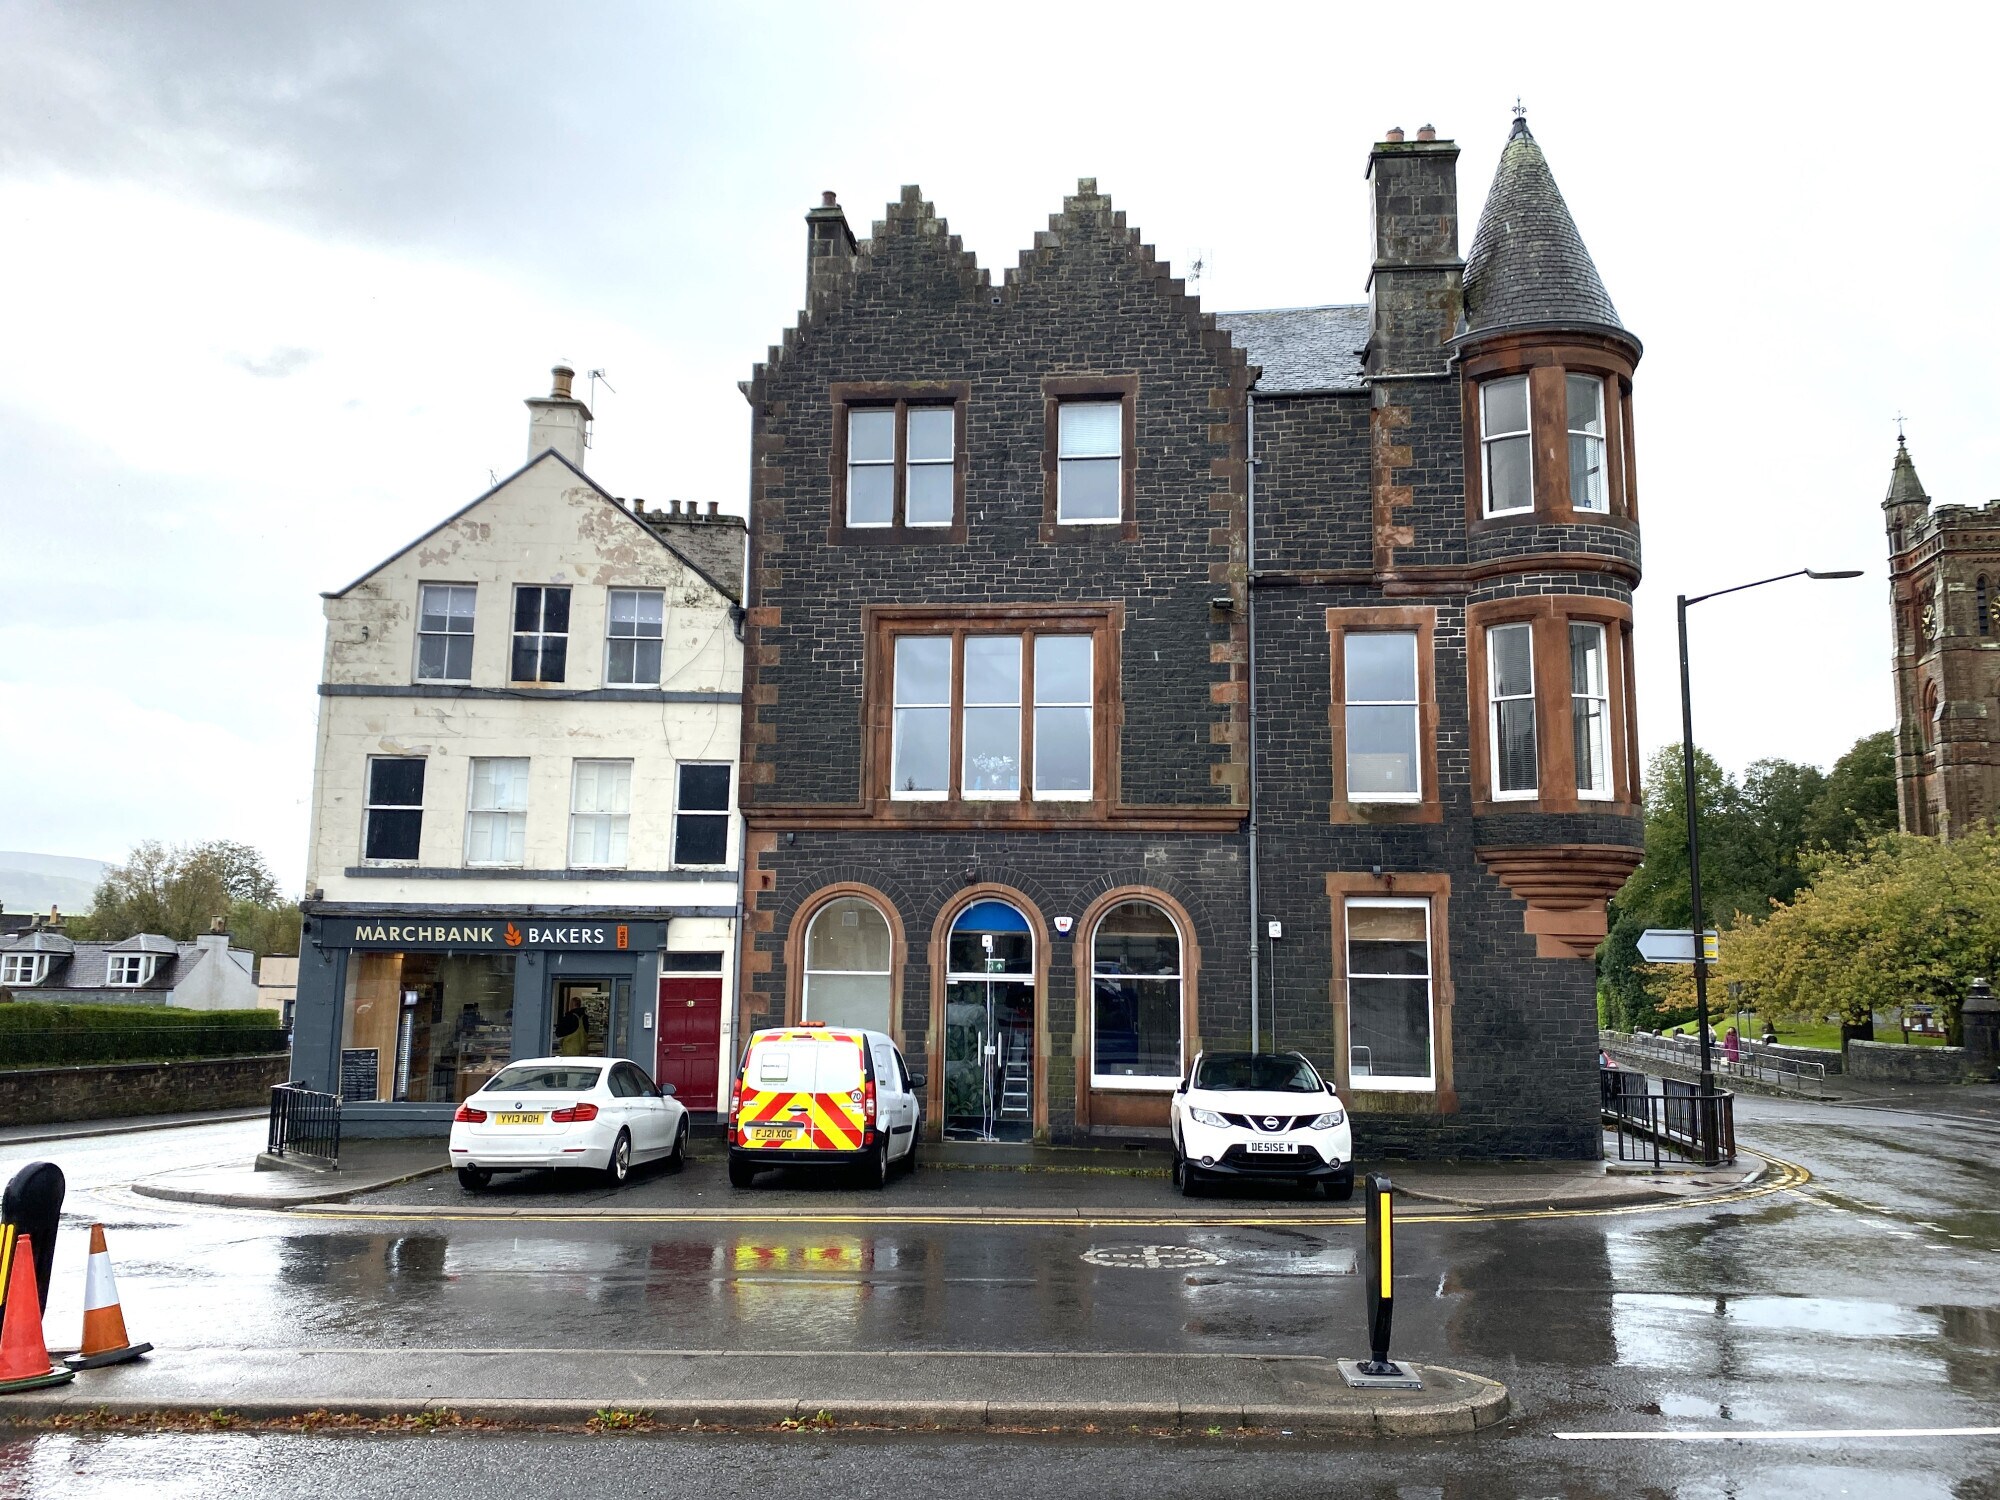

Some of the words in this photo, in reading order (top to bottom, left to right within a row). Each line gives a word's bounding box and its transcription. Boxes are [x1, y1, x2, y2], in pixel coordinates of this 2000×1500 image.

[355, 926, 494, 942] MARCHBANK
[528, 928, 605, 943] BAKERS
[853, 1092, 861, 1101] 70
[501, 1114, 520, 1123] YY13
[755, 1129, 775, 1138] FJ21
[776, 1129, 792, 1138] XOG
